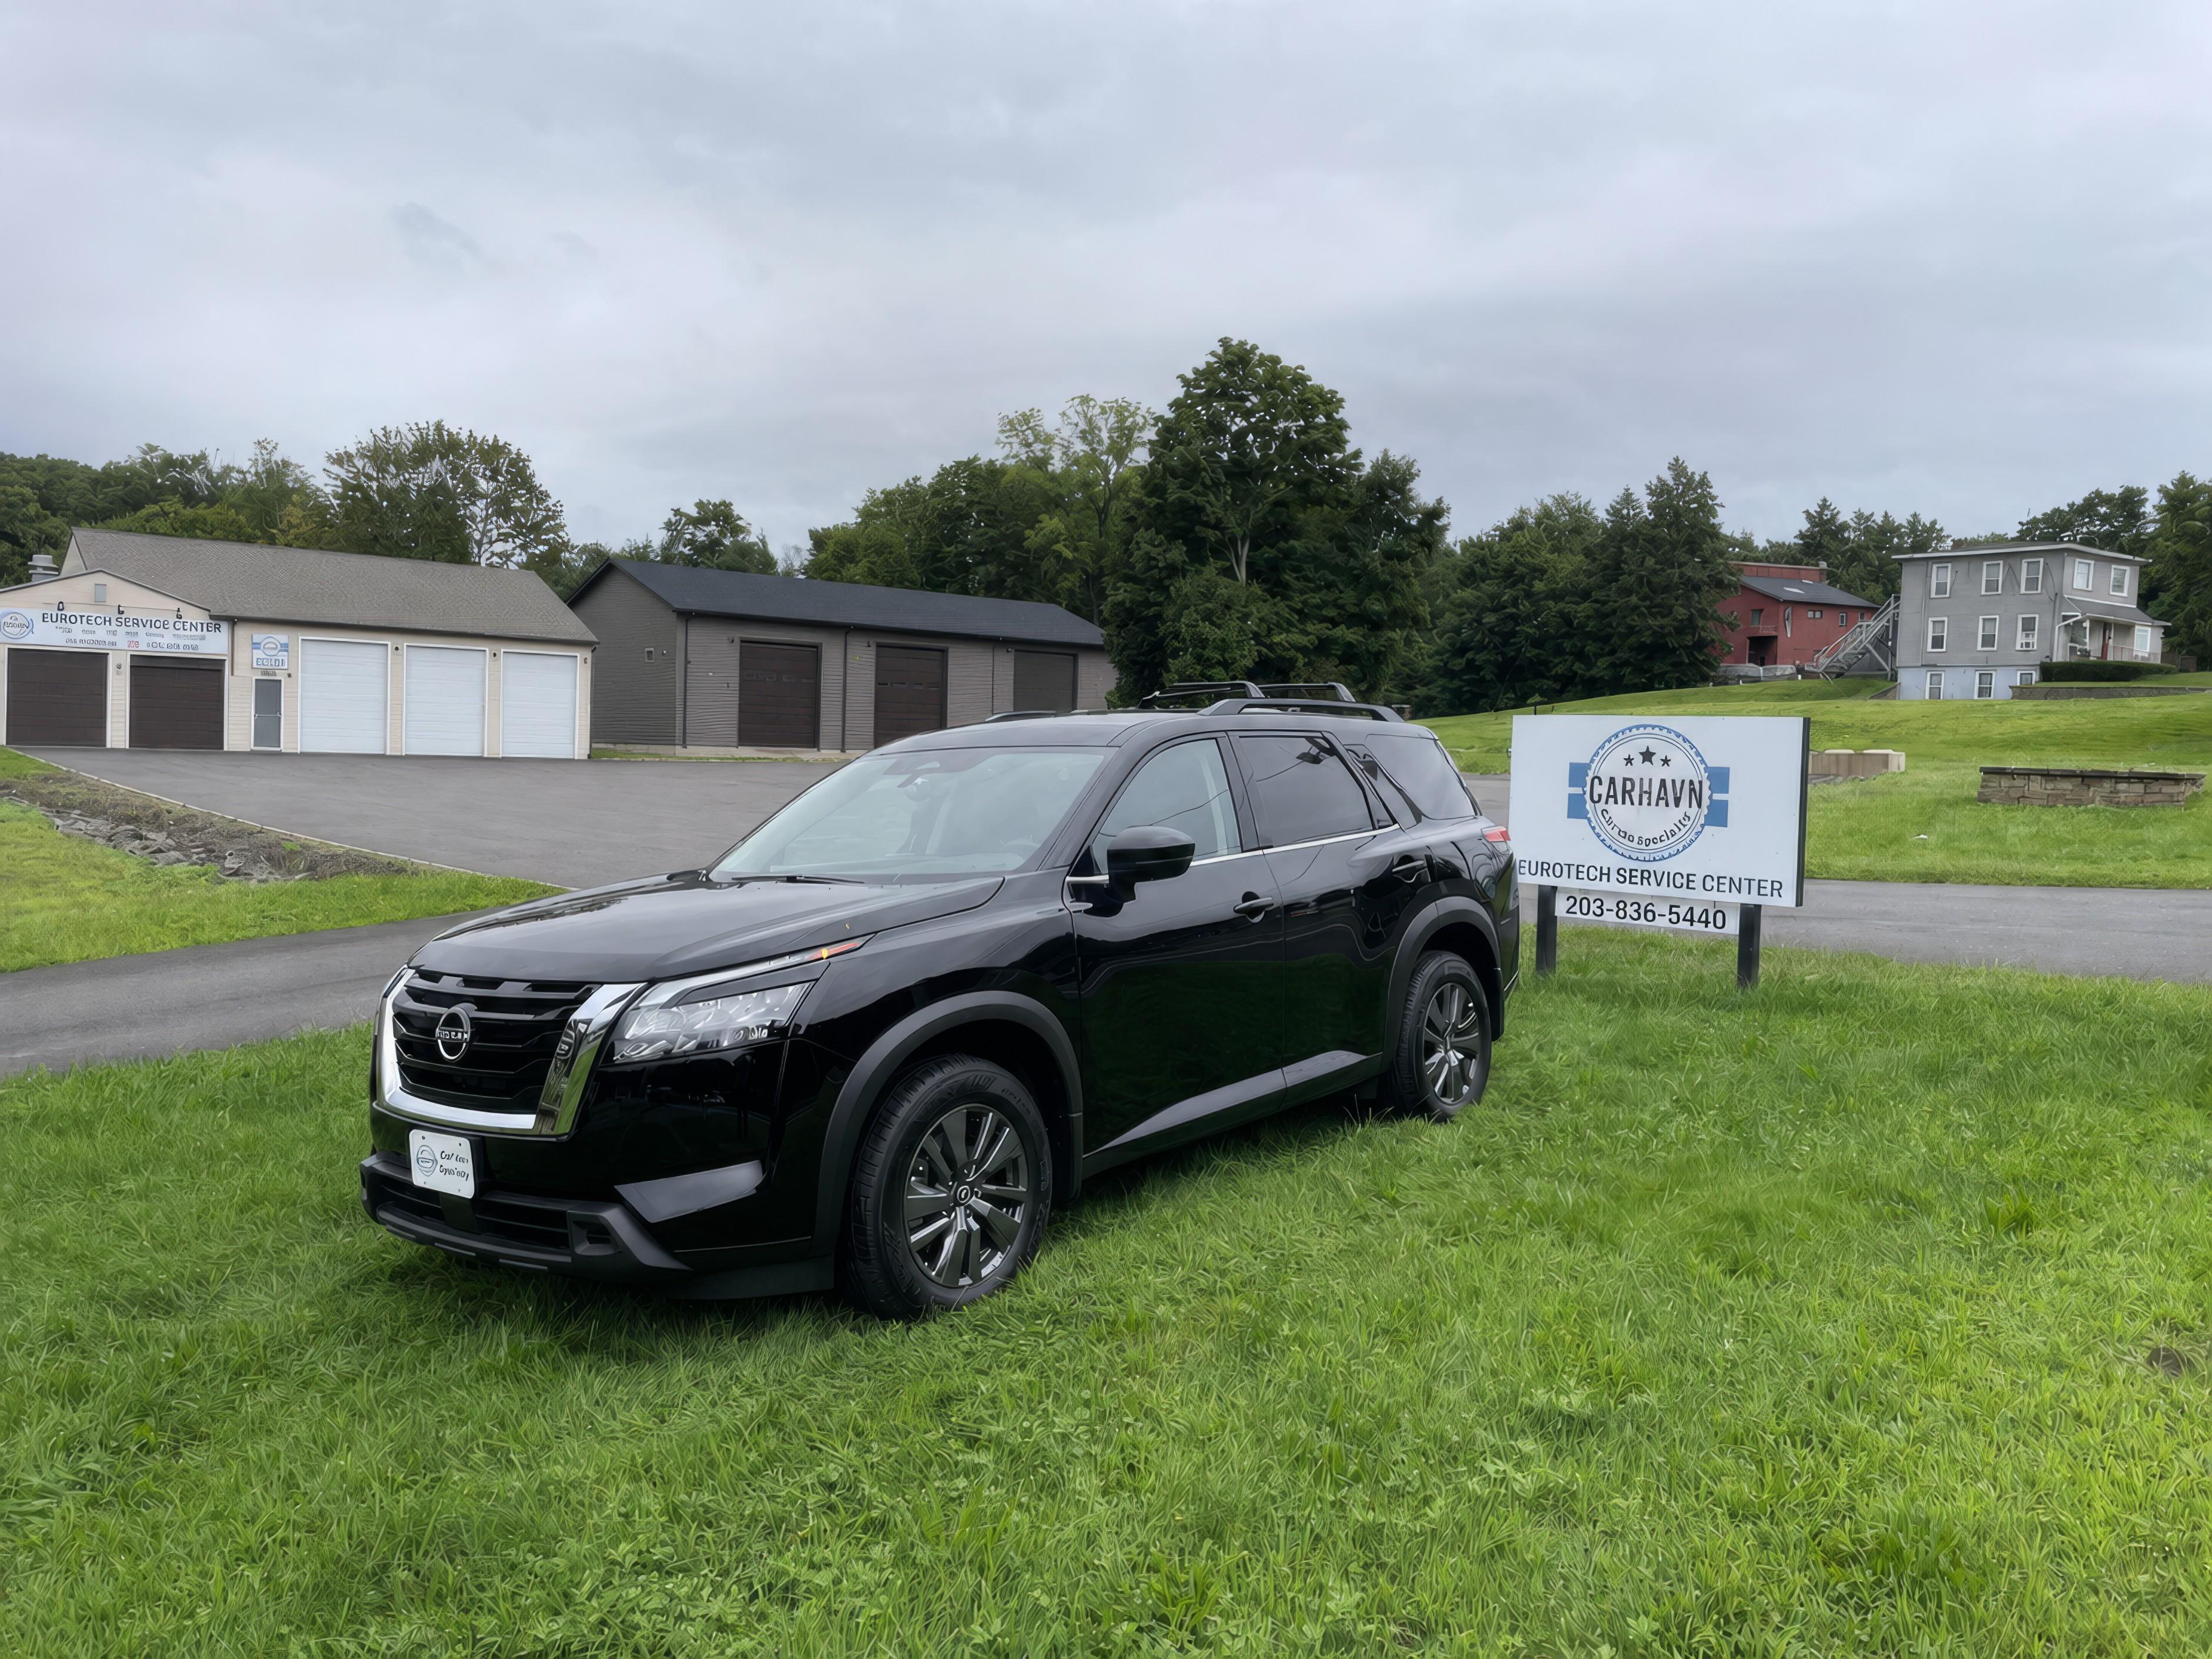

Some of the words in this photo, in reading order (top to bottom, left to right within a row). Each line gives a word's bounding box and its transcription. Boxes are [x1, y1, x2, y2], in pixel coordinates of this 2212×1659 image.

[42, 612, 112, 626] EUROTECH
[172, 621, 222, 634] CENTER
[1589, 775, 1703, 810] CARHAVN
[1518, 859, 1611, 883] EUROTECH
[1616, 867, 1697, 890] SERVICE
[1702, 874, 1783, 898] CENTER
[1565, 895, 1727, 930] 203-836-5440
